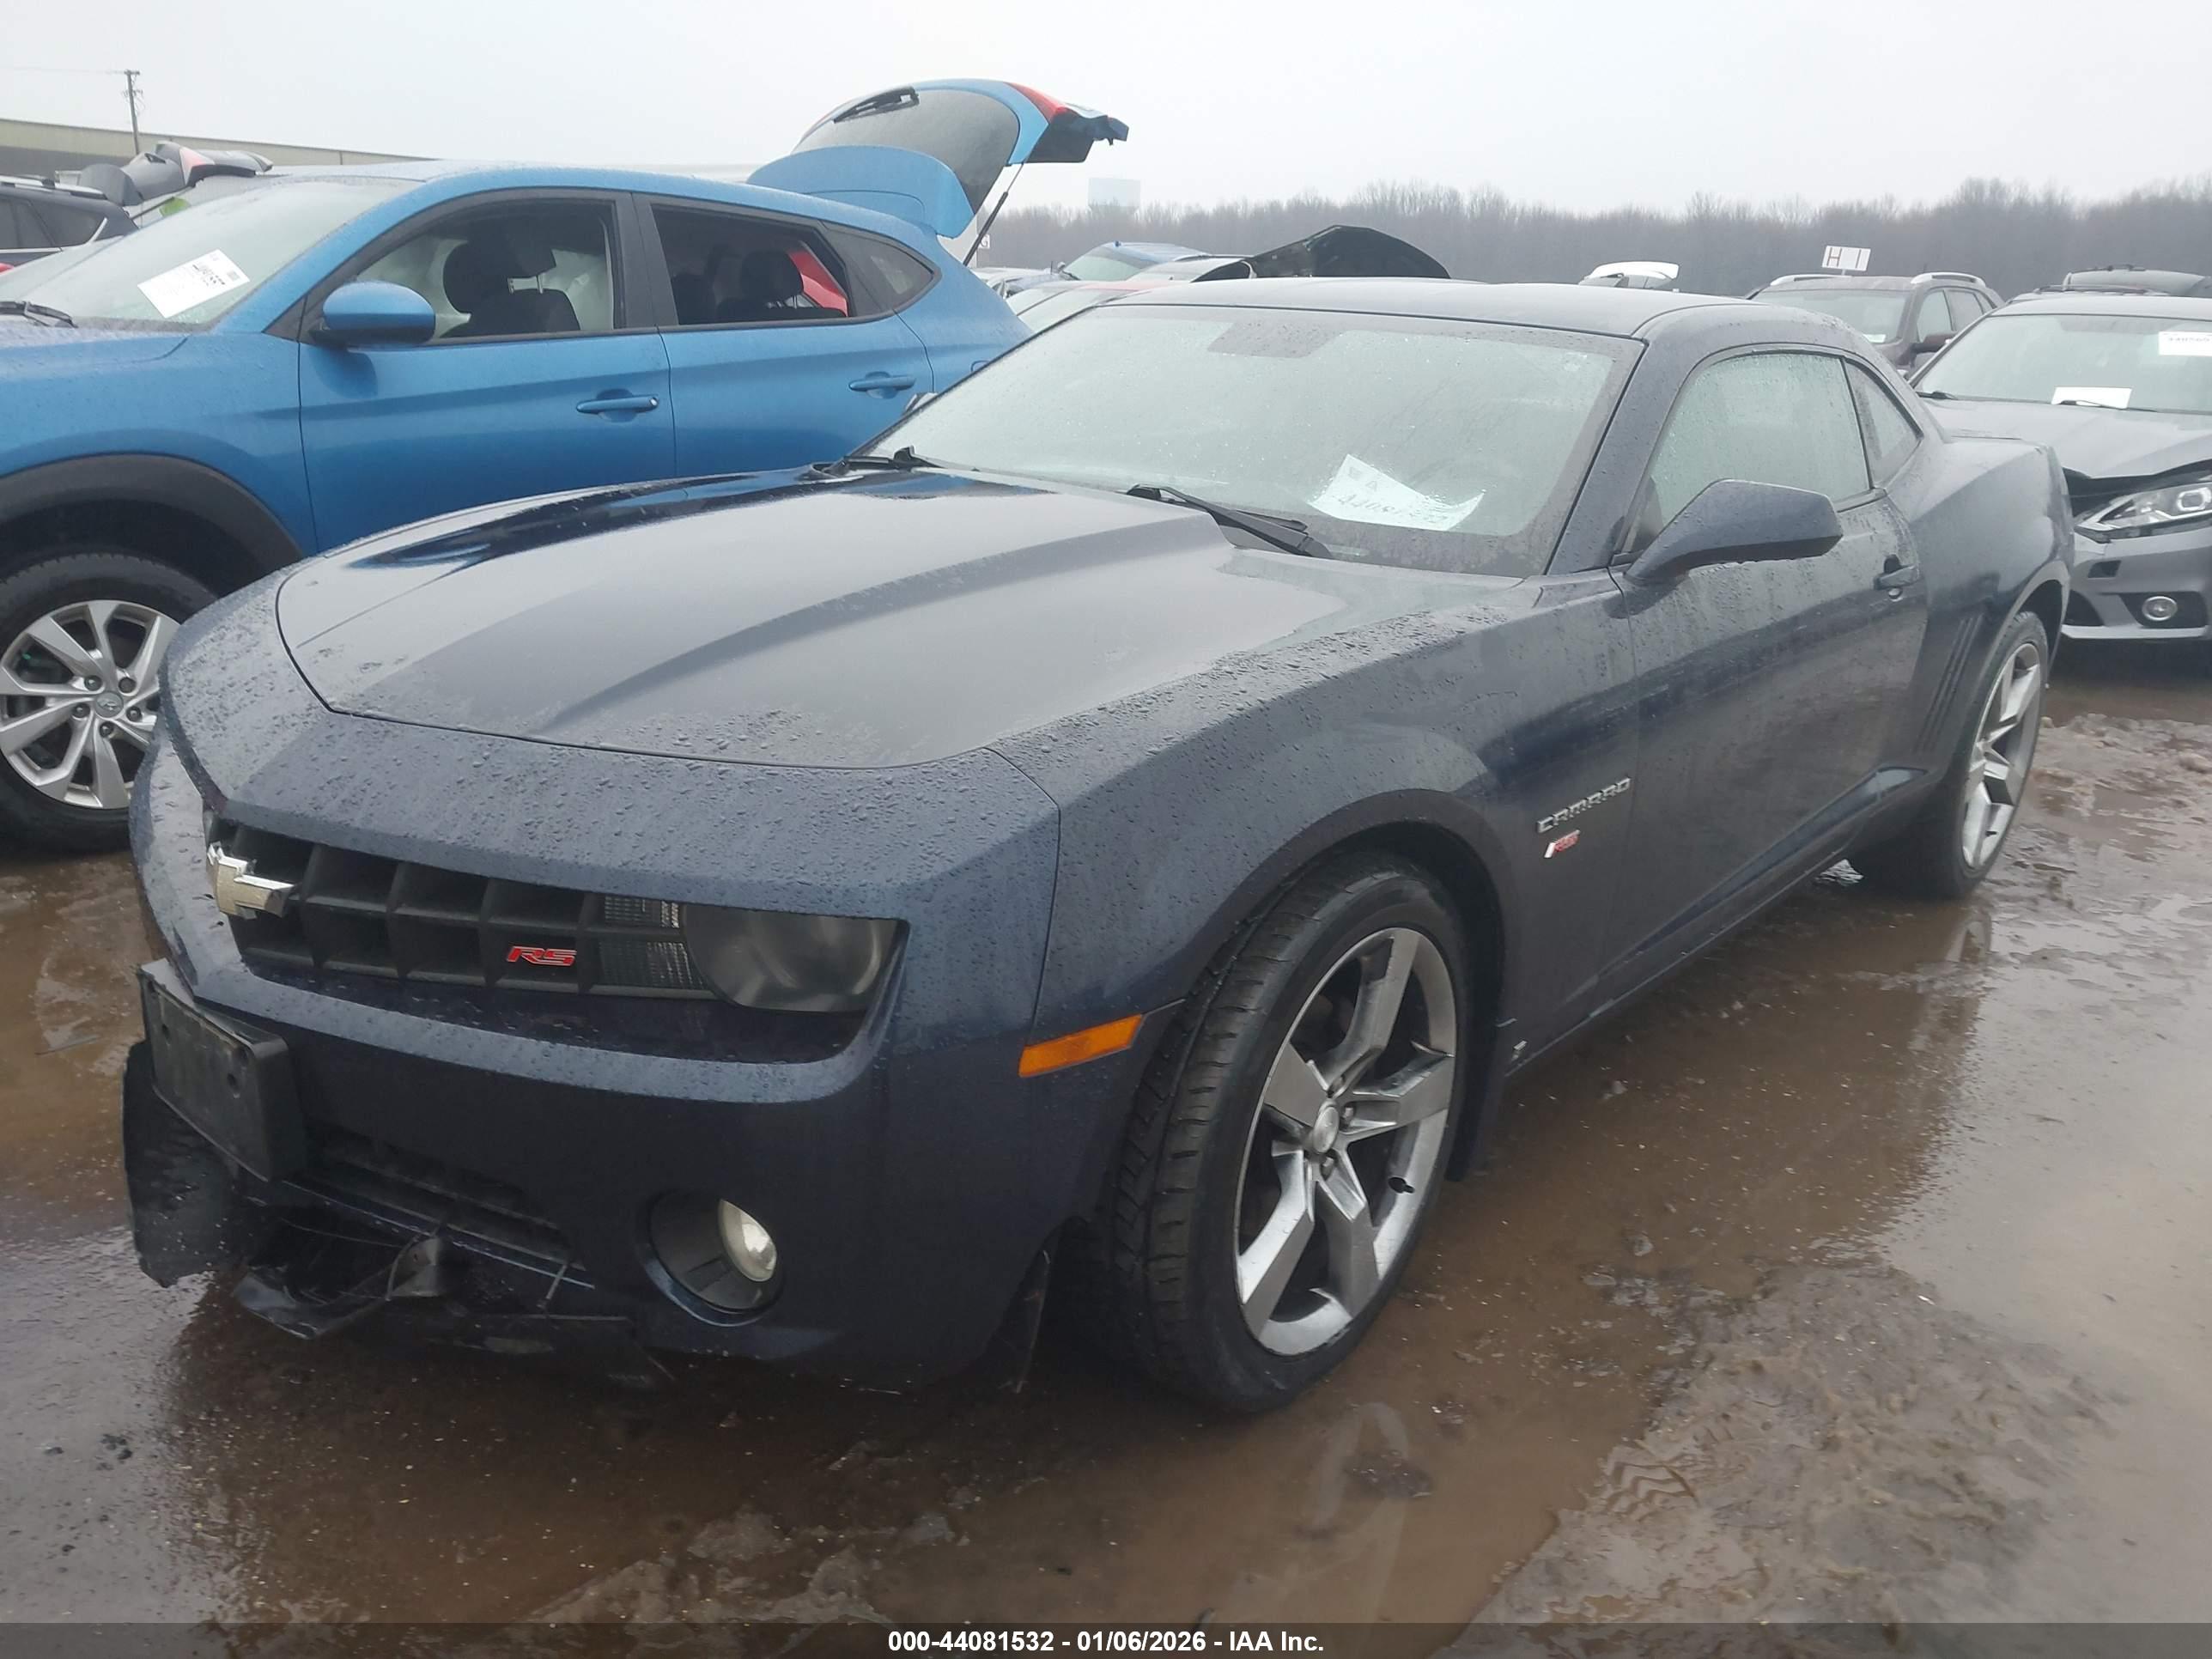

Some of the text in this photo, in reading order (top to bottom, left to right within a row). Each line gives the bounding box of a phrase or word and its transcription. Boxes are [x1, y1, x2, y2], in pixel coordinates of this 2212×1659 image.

[1826, 247, 1843, 267] H
[1537, 777, 1631, 833] CAMARO
[507, 945, 577, 966] RS
